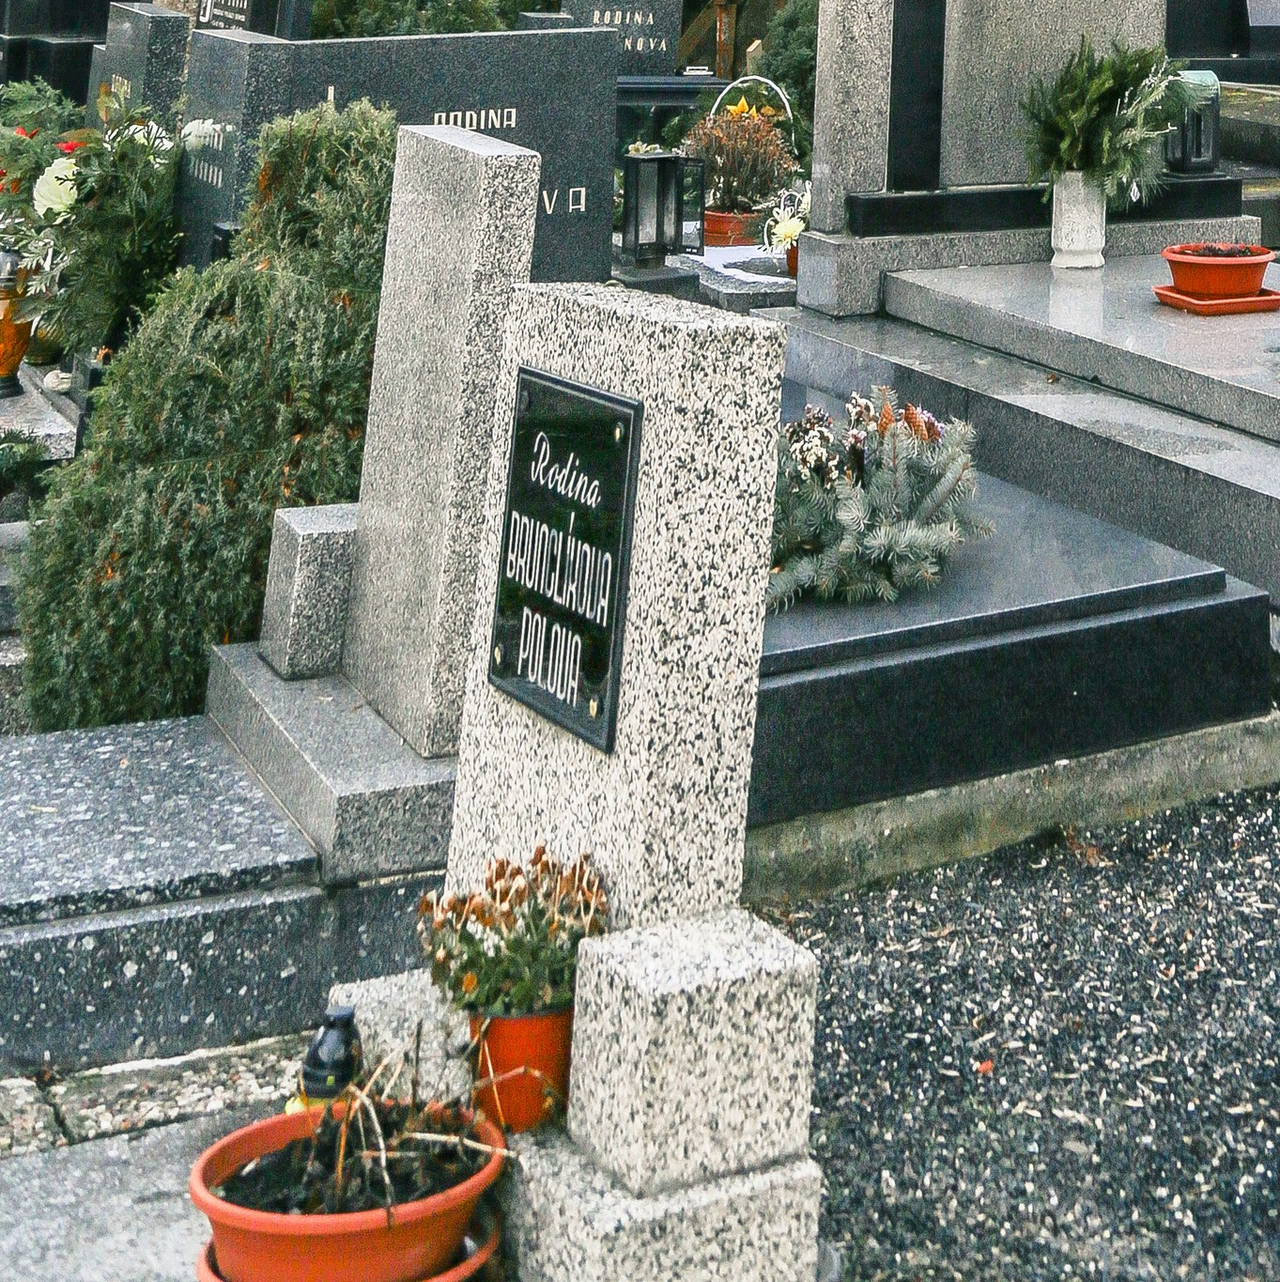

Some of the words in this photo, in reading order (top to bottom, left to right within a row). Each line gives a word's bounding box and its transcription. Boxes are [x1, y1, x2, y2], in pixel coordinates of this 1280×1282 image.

[593, 10, 654, 25] RODINA
[624, 36, 667, 51] NOVA
[530, 431, 601, 508] Rodina
[506, 510, 612, 628] BRUNCLÍKOVA
[517, 606, 582, 708] POLOVA
